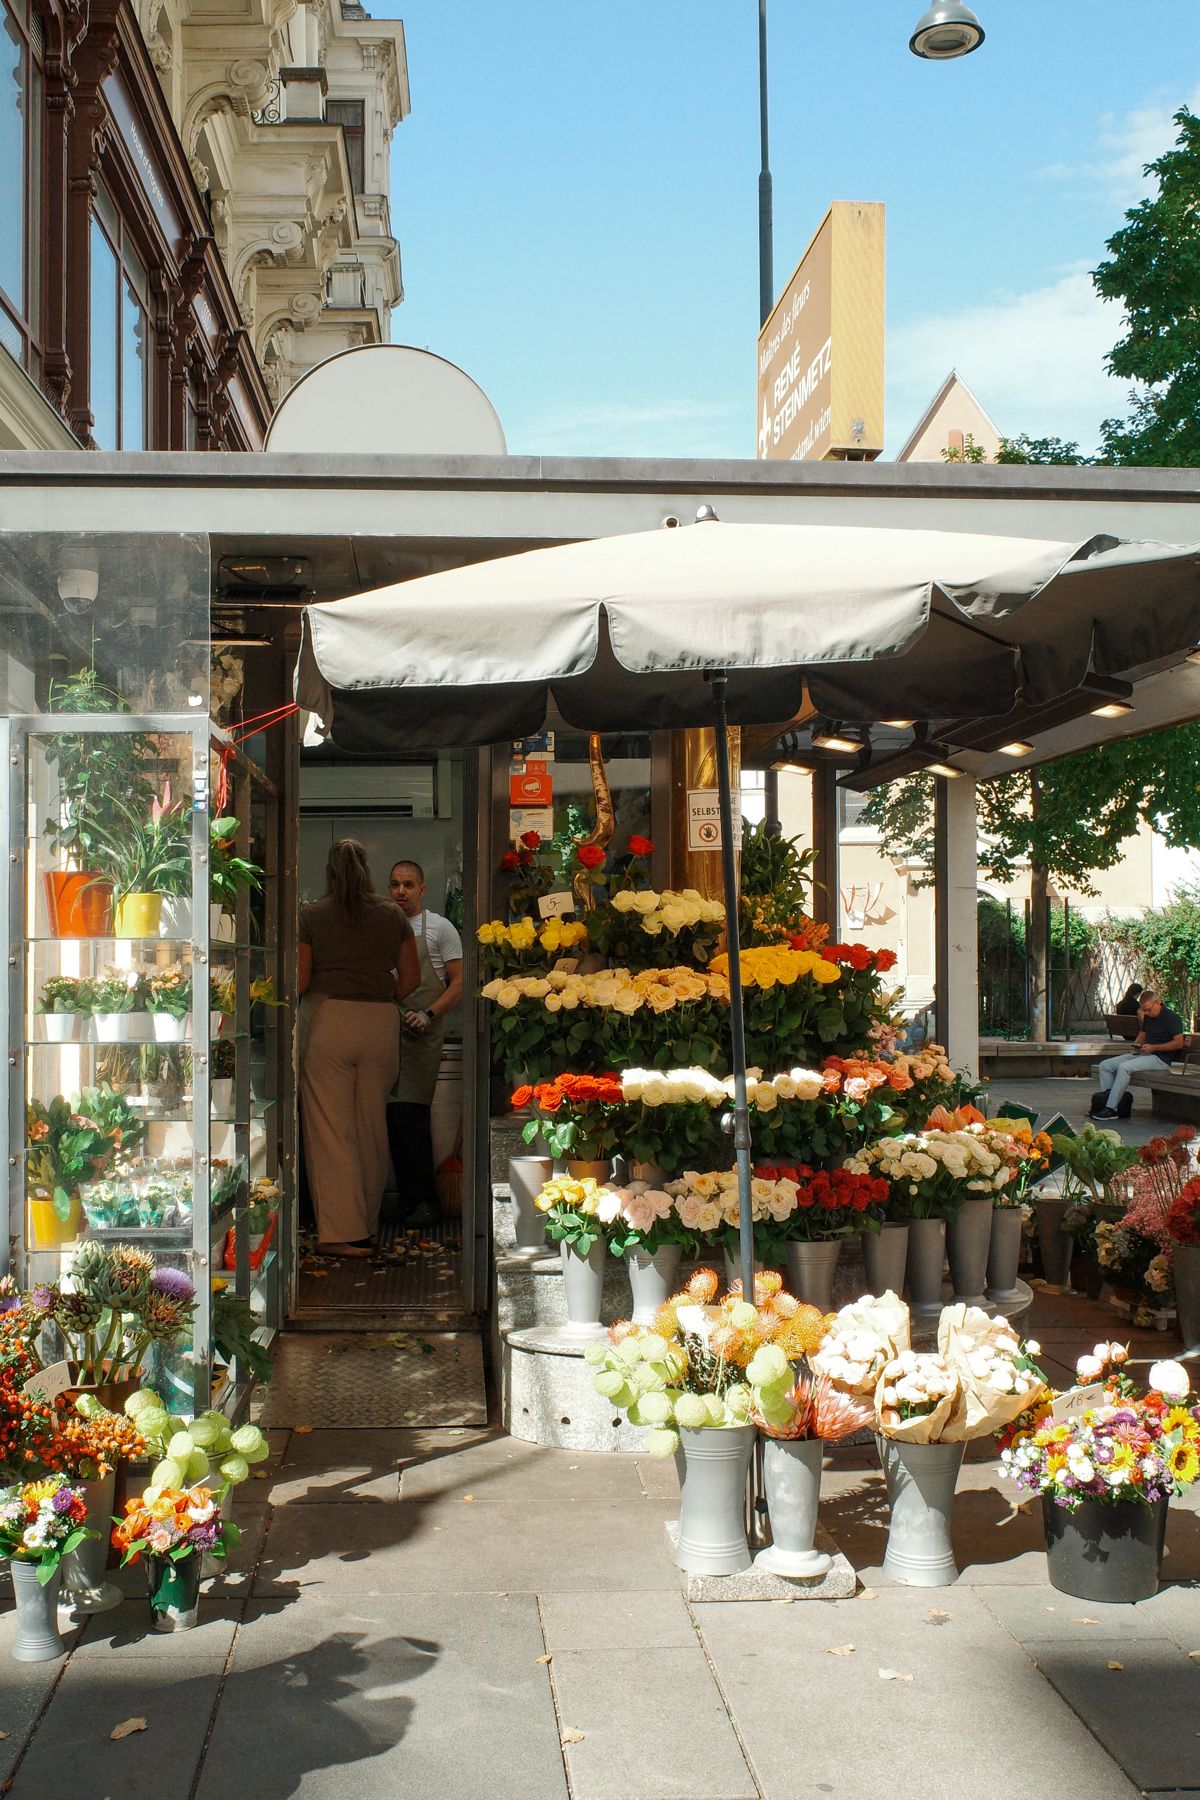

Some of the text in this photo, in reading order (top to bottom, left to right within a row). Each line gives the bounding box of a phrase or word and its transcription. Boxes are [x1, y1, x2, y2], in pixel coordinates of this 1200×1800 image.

[130, 121, 144, 160] House
[780, 312, 792, 342] des
[790, 279, 810, 335] fleurs
[773, 339, 801, 409] RENÉ
[773, 335, 832, 446] STEINMETZ
